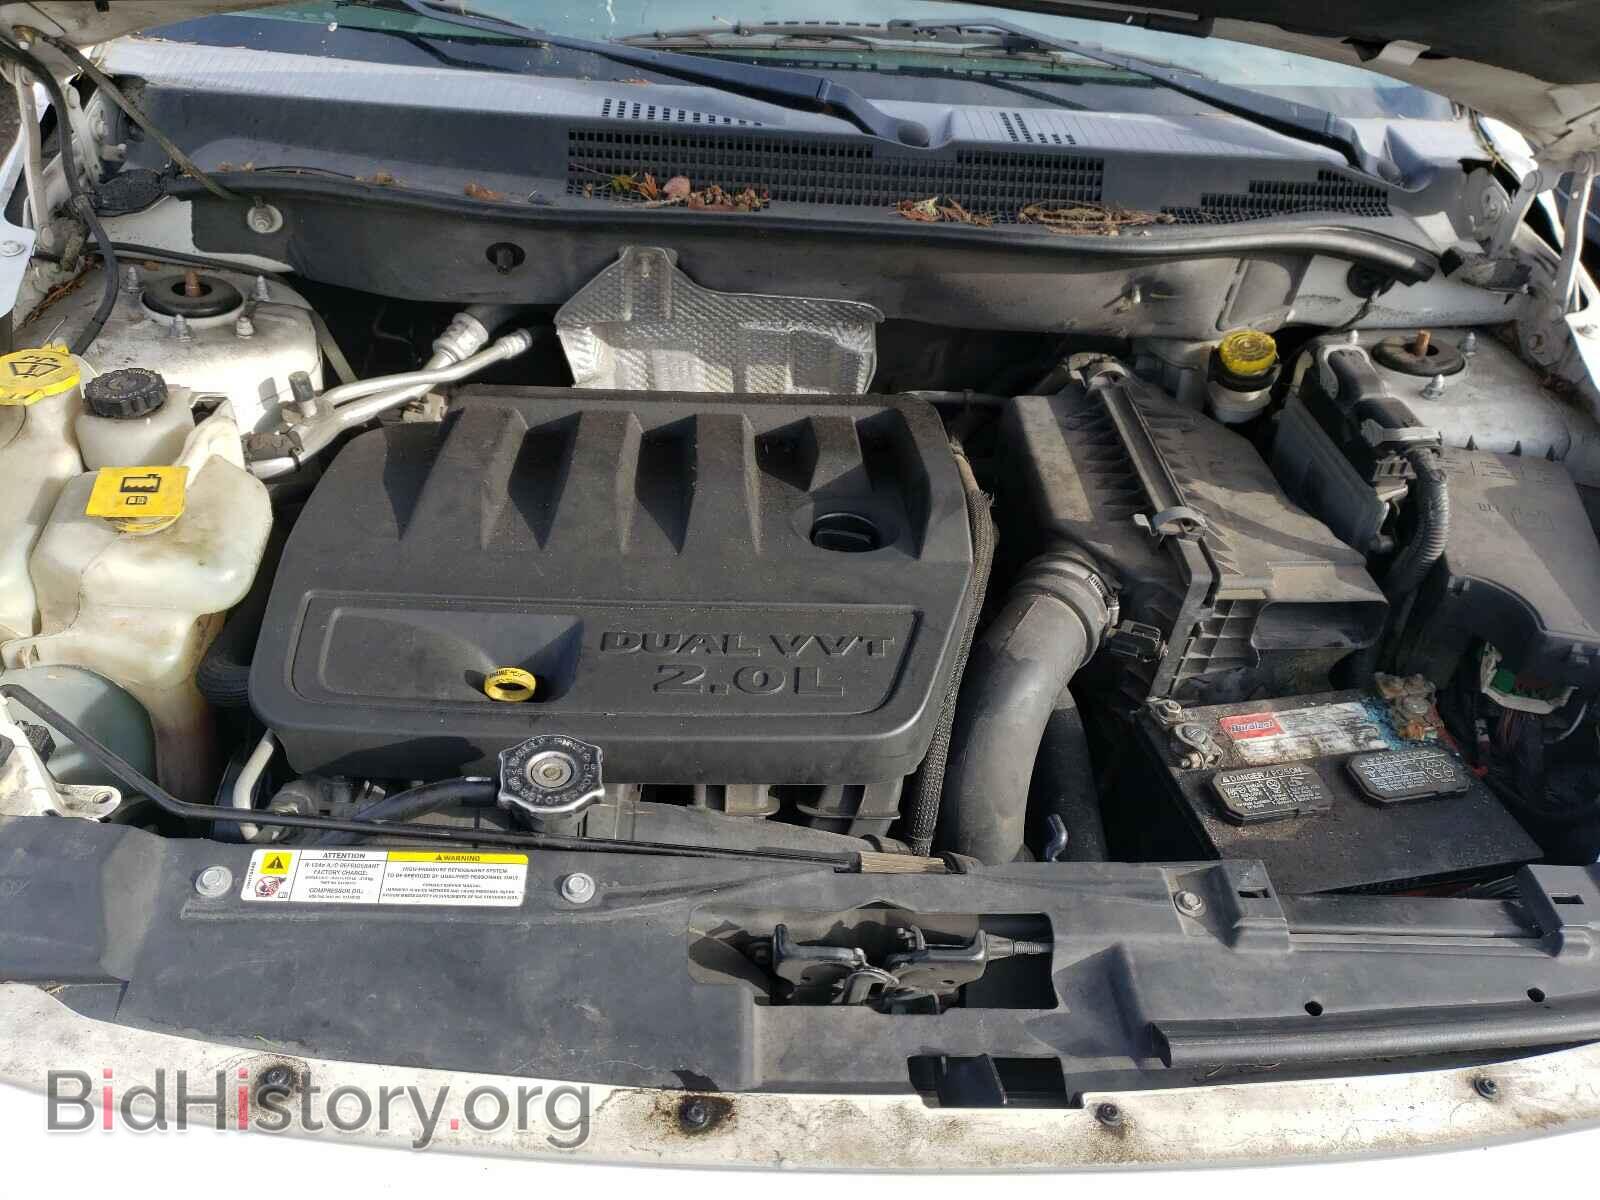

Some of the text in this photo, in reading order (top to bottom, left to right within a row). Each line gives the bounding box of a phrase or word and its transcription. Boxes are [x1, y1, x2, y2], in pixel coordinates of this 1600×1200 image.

[600, 631, 895, 657] DUAL VVT
[652, 664, 844, 696] 2.0L
[1230, 772, 1265, 782] DANGER
[1270, 767, 1302, 777] POISON
